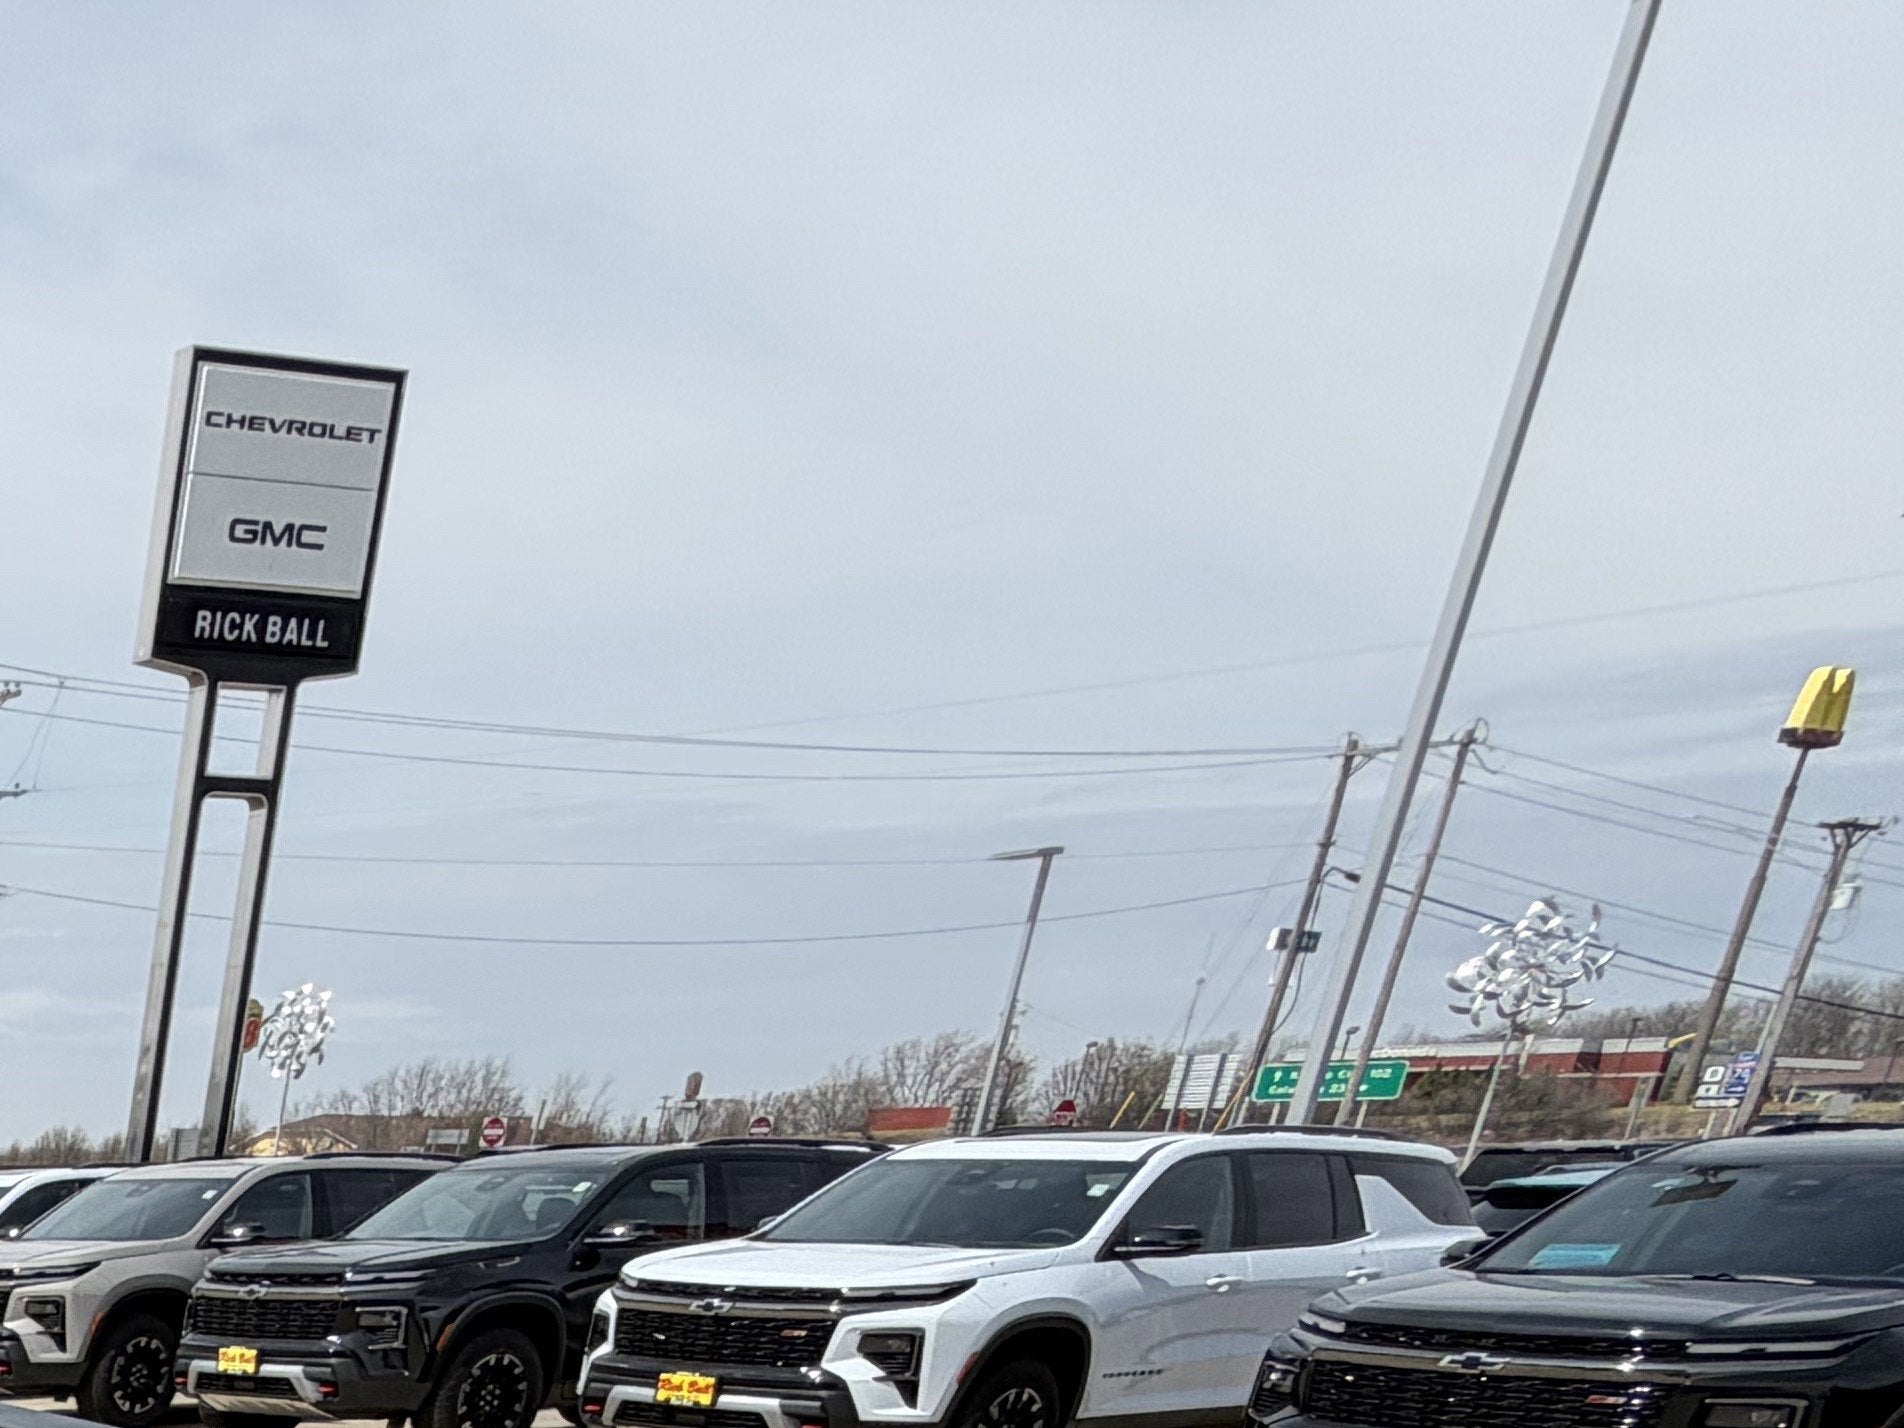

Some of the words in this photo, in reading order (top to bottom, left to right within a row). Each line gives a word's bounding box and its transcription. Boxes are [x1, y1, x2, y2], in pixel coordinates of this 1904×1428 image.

[205, 411, 382, 444] CHEVROLET
[228, 518, 327, 551] GMC
[194, 609, 260, 643] RICK
[264, 615, 329, 648] BALL
